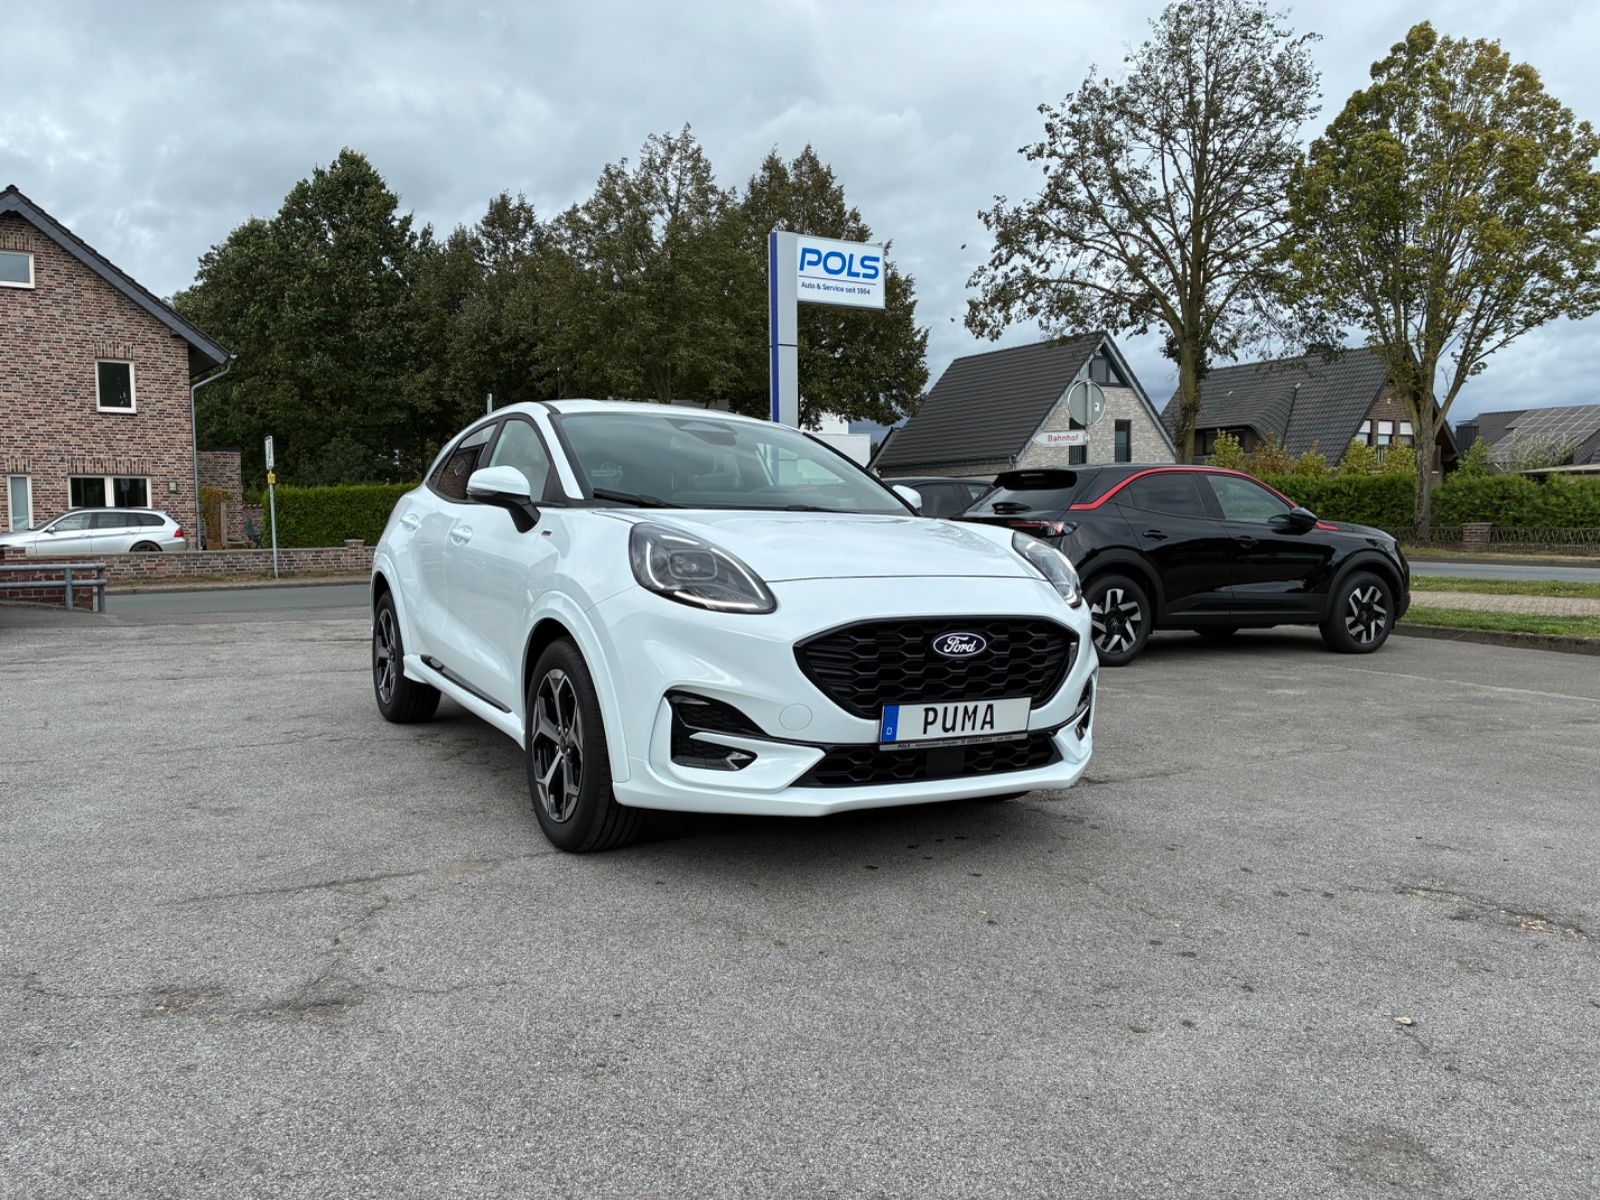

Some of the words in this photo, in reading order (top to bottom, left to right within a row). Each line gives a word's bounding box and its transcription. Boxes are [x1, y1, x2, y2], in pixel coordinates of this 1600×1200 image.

[799, 247, 880, 280] POLS
[822, 284, 844, 293] Service
[1047, 433, 1079, 442] Bahnhof
[944, 635, 977, 653] Ford
[923, 703, 995, 735] PUMA
[885, 727, 893, 736] D
